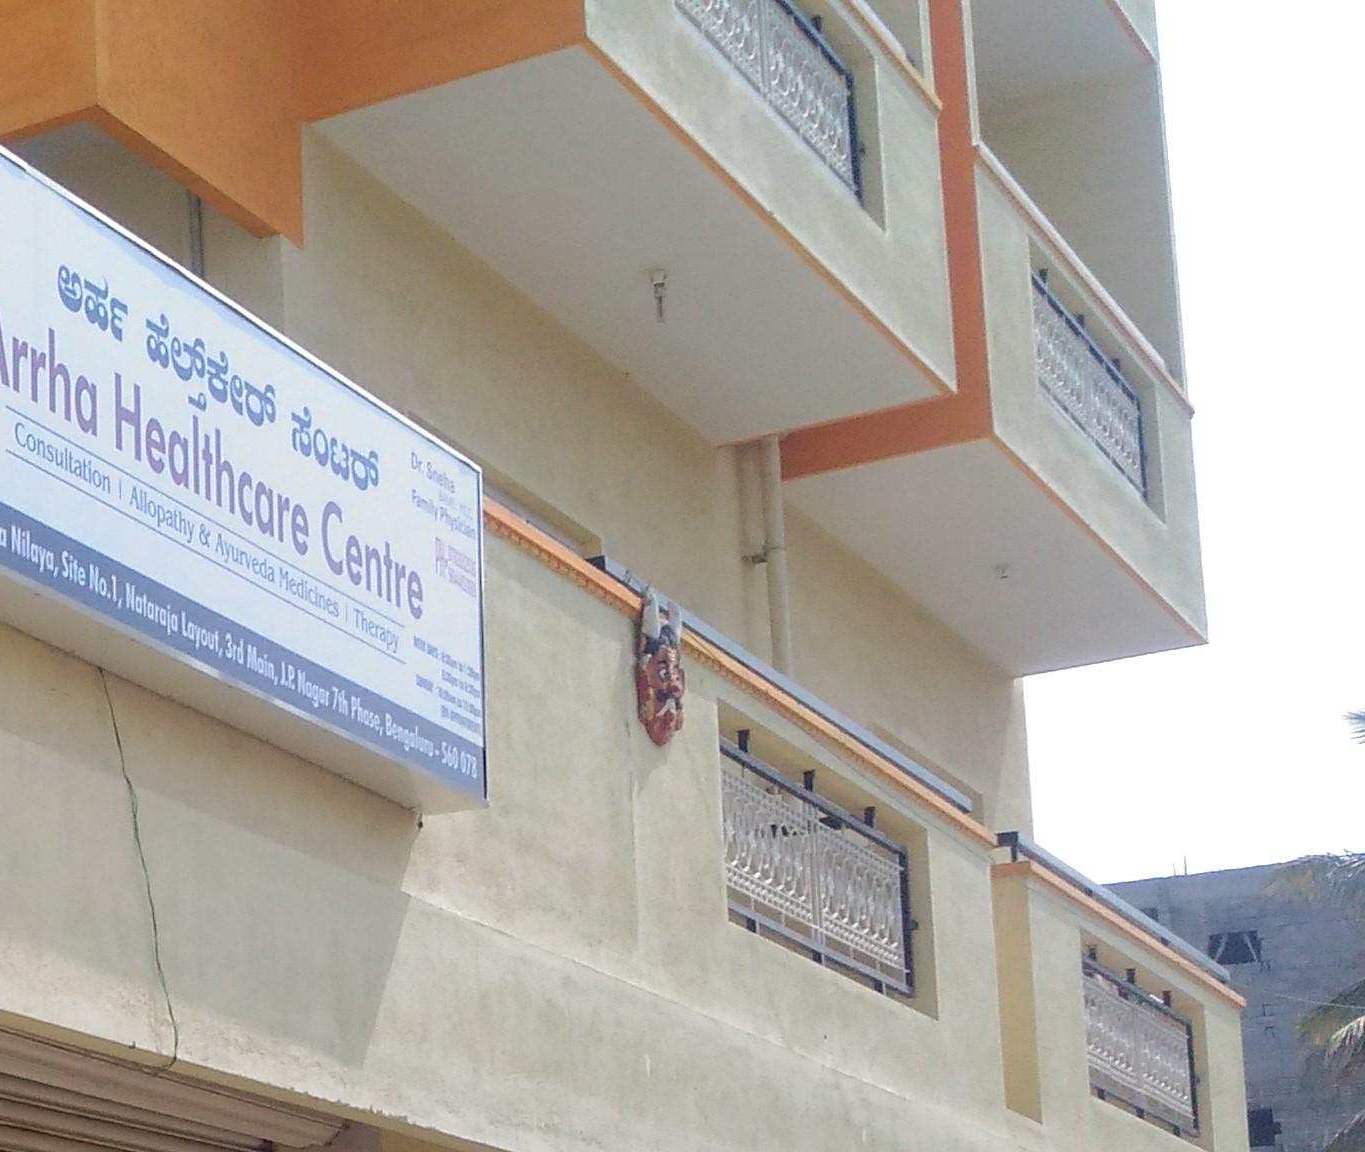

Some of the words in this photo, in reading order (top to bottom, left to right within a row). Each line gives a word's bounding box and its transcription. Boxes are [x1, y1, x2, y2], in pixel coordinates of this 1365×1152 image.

[14, 422, 111, 493] Consultation
[129, 486, 196, 544] Allopathy
[199, 523, 210, 547] &
[215, 533, 275, 584] Ayurveda
[279, 567, 340, 617] Medicines
[353, 608, 399, 653] Therapy
[114, 372, 309, 557] Healthcare
[321, 501, 424, 620] Centre
[11, 525, 60, 578] Nilaya,
[62, 550, 86, 586] Site
[89, 564, 123, 608] No.1,
[126, 582, 179, 636] Nataraja
[181, 613, 223, 658] Layout,
[225, 633, 244, 665] 3rd
[247, 645, 278, 685] Main,
[297, 670, 330, 708] Nagar
[331, 687, 348, 715] 7th
[351, 696, 383, 737] Phase,
[385, 713, 434, 757] Bengaluru
[441, 742, 458, 770] 560
[461, 751, 478, 778] 078
